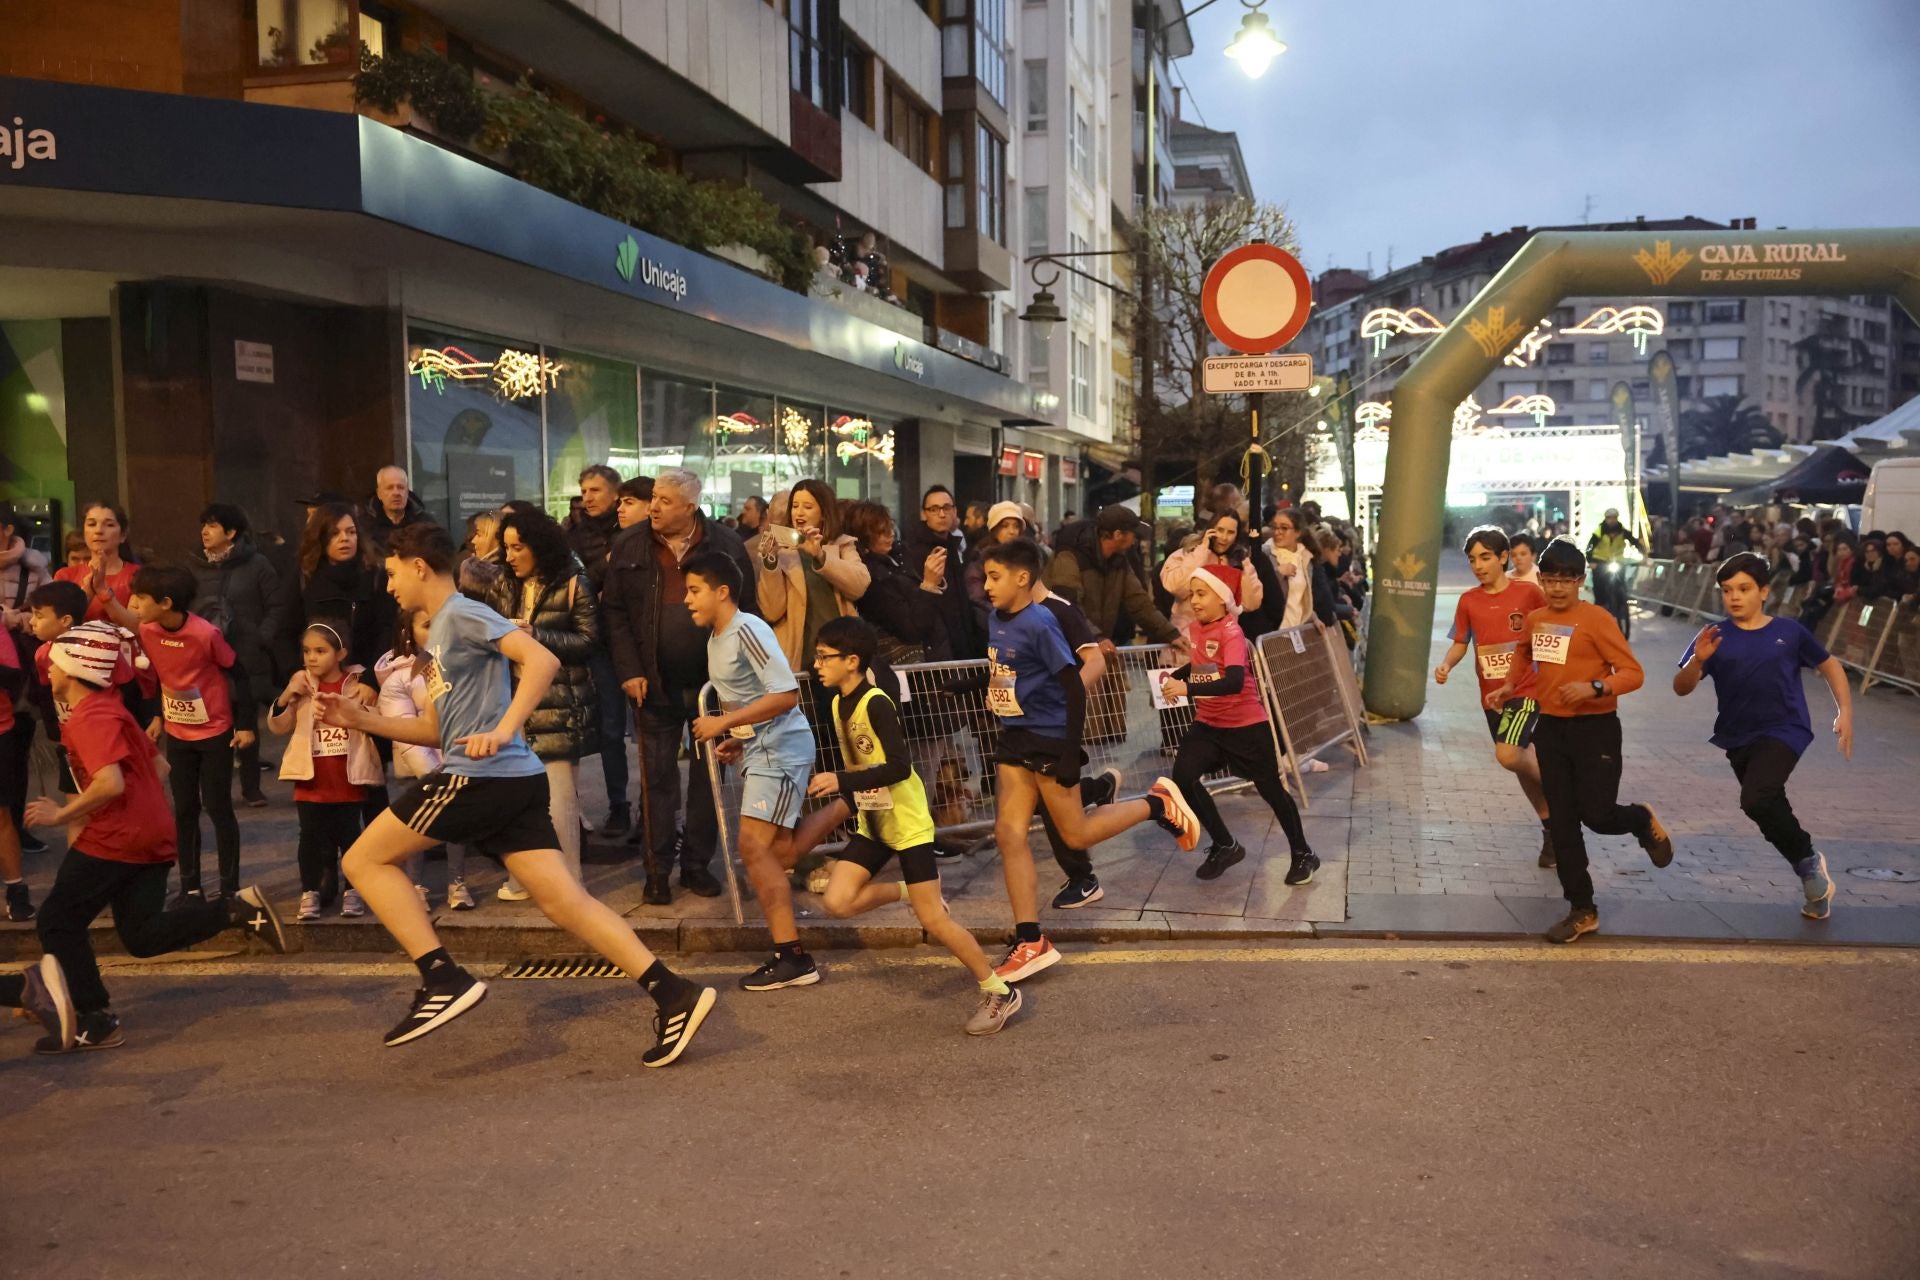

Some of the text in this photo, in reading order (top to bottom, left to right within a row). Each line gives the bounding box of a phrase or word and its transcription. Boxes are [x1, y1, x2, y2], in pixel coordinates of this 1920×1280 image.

[1700, 243, 1847, 264] CAJA RURAL
[641, 256, 687, 302] Unicaja
[1701, 268, 1802, 281] DE ASTURIAS
[1207, 362, 1239, 370] EXCEPTO
[1239, 361, 1263, 369] CARGA
[1270, 360, 1307, 368] DESCARGA
[1535, 634, 1562, 648] 1595
[1485, 653, 1513, 667] 1556
[990, 689, 1012, 703] 1582
[165, 697, 196, 712] 1493
[315, 728, 350, 743] 1243
